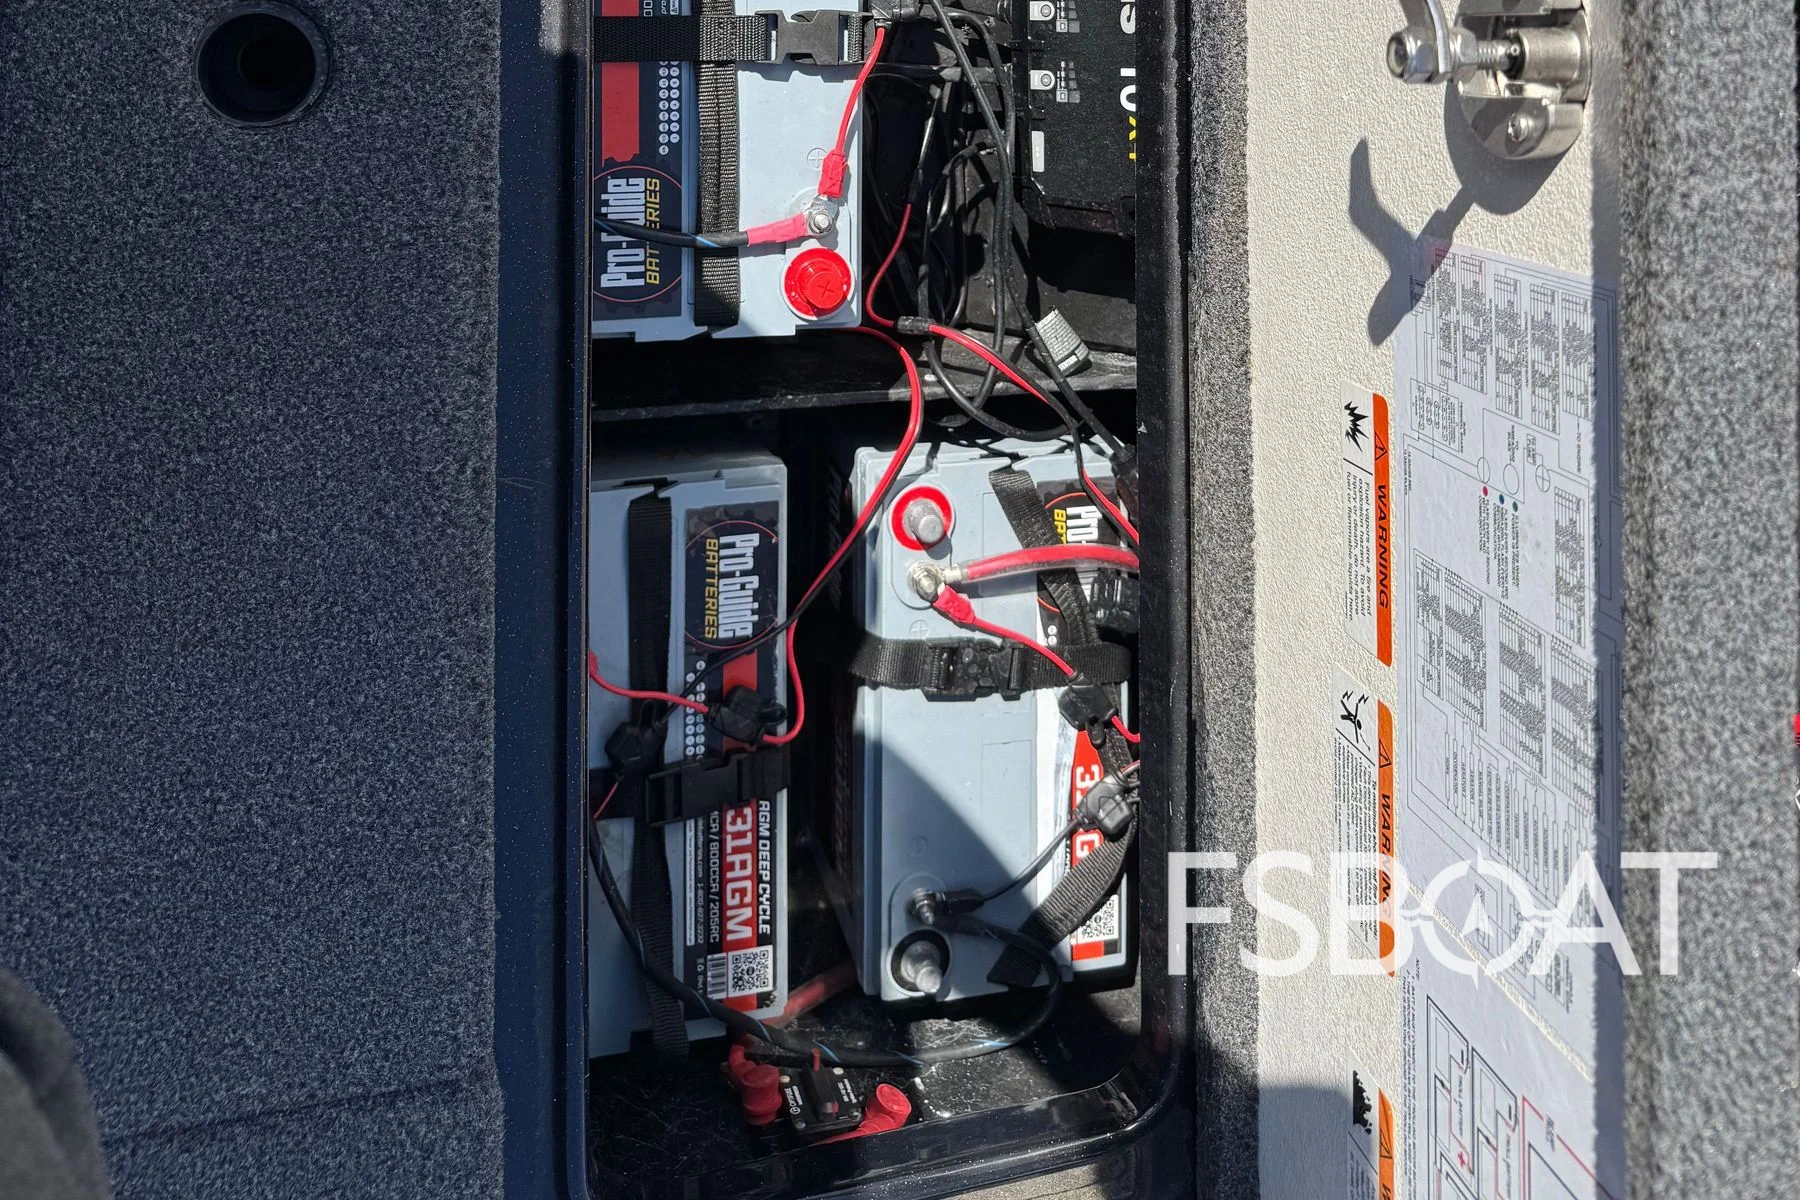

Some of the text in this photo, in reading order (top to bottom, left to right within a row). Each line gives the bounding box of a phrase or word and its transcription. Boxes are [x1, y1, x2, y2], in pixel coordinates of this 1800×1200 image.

[704, 538, 719, 640] BATTERIES
[718, 532, 760, 638] Pro-Guide
[1377, 484, 1389, 609] WARNING
[709, 902, 720, 943] 205RC
[726, 806, 753, 941] 31AGM
[758, 800, 771, 935] AGM DEEP CYCLE
